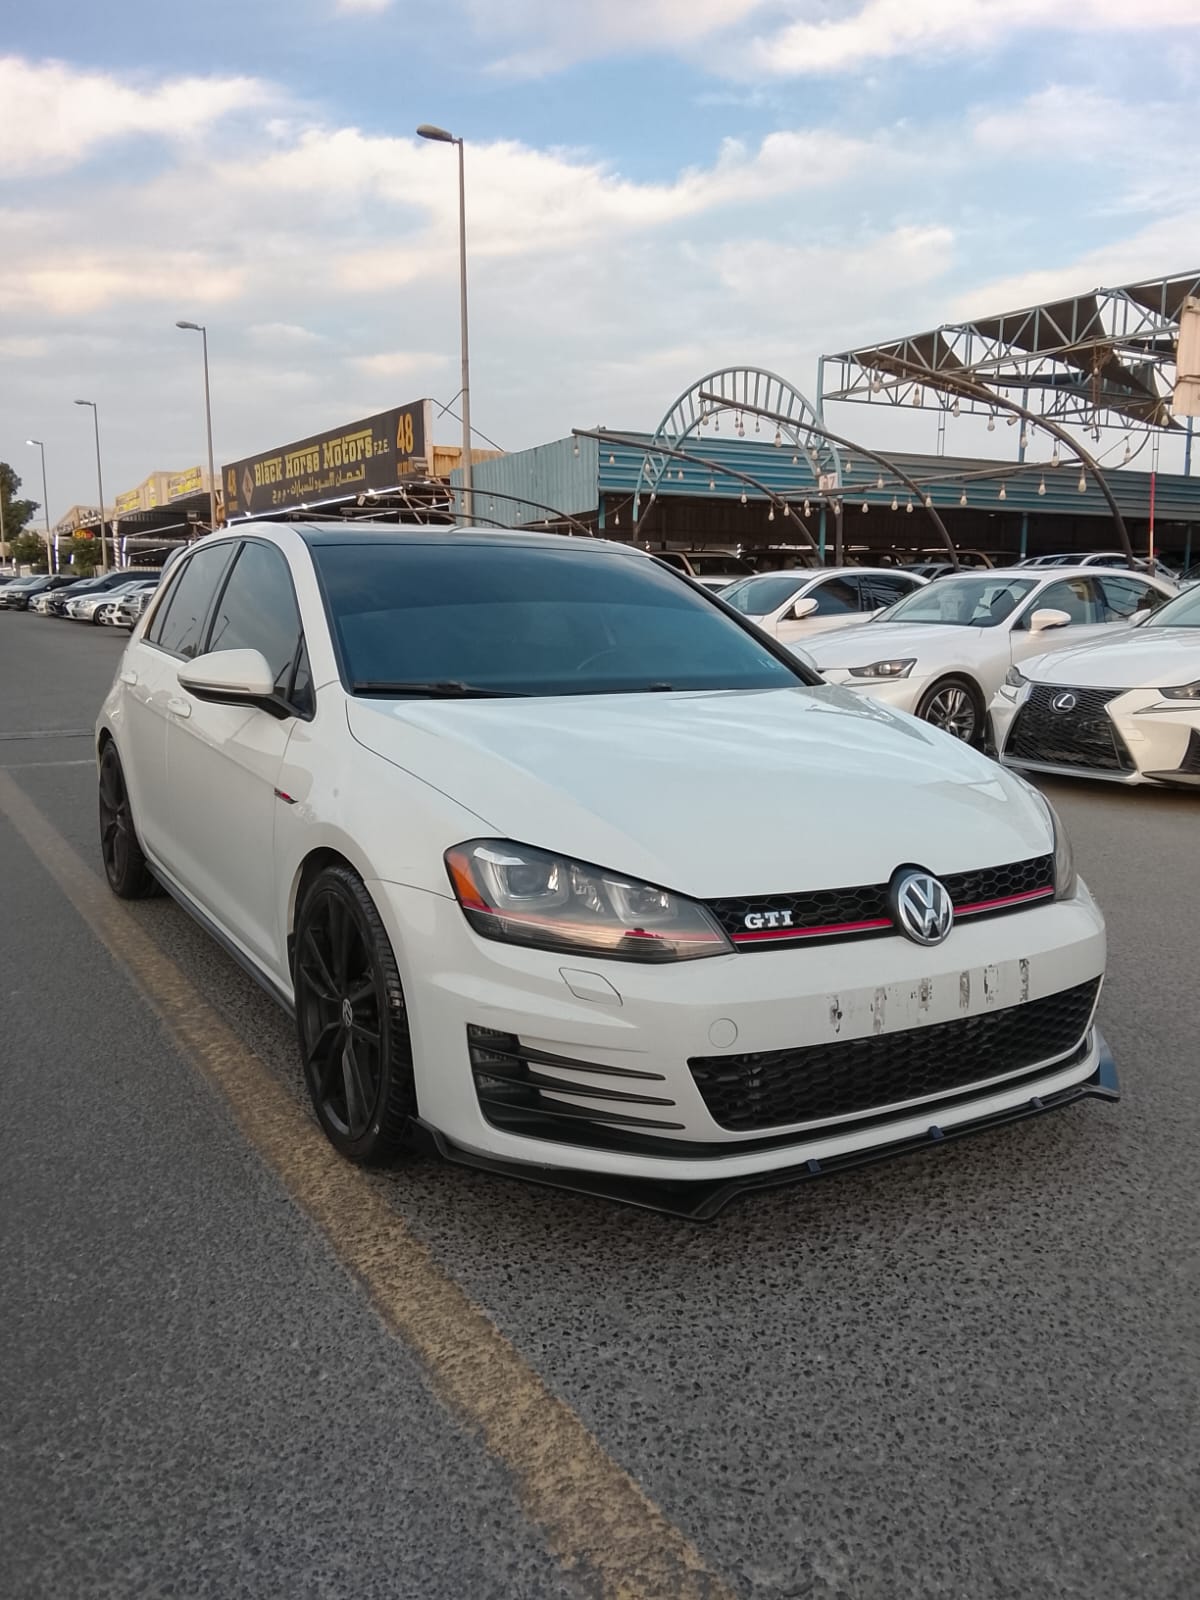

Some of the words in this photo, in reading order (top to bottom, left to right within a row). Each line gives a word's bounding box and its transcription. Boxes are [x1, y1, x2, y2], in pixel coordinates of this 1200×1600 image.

[396, 413, 414, 454] 48
[254, 456, 283, 487] Black
[284, 445, 320, 479] Horse
[322, 428, 373, 469] Motors
[744, 910, 794, 929] GTI
